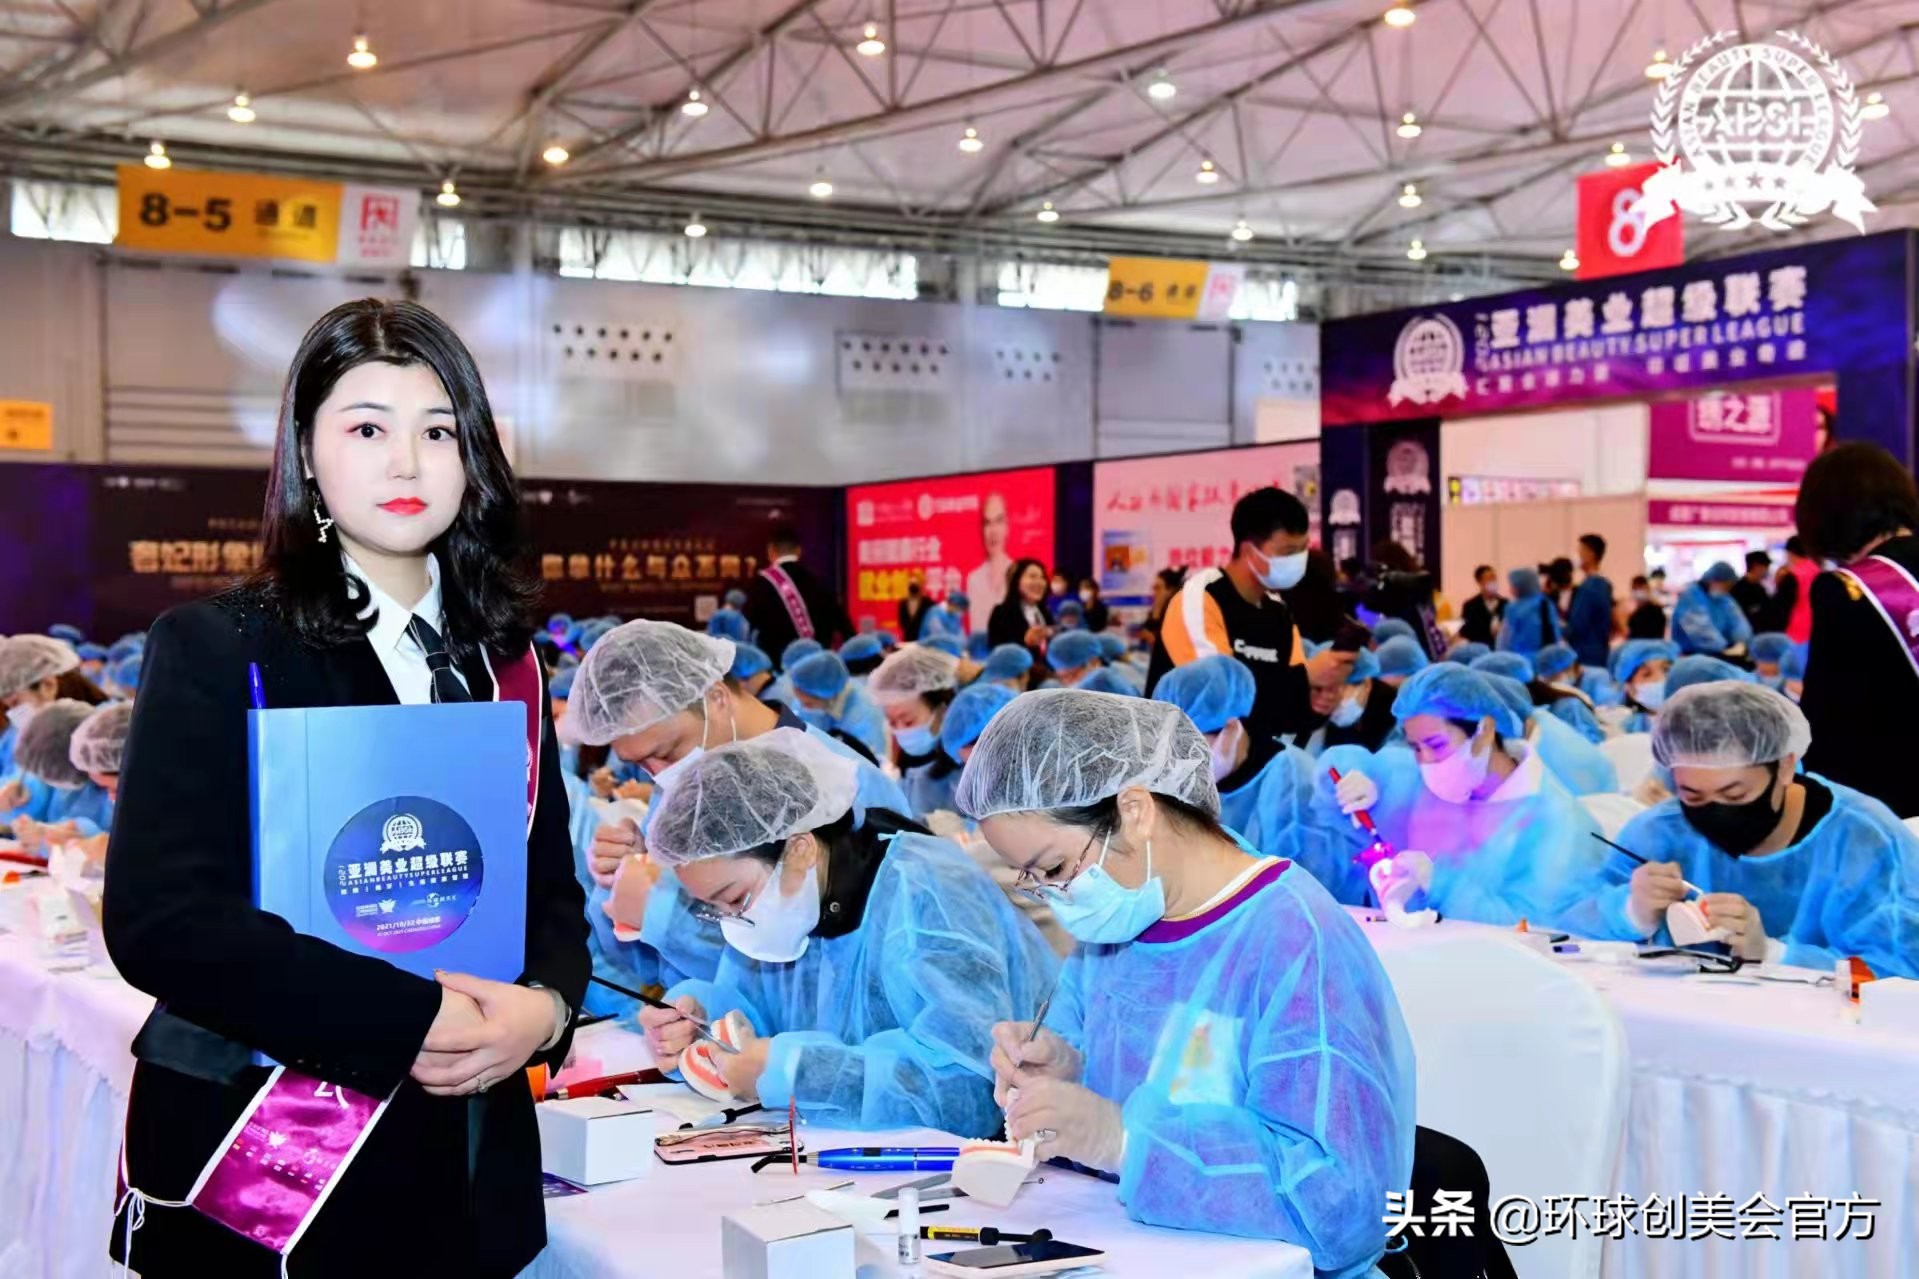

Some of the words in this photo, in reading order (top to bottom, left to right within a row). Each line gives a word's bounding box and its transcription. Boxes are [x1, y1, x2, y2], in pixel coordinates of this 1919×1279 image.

[140, 193, 232, 233] 8-5
[1607, 187, 1649, 258] 8
[1490, 265, 1807, 348] 亚洲美业超级联赛
[1489, 346, 1549, 371] ASIAN
[1551, 335, 1632, 364] BEAUTY
[1634, 325, 1709, 355] SUPER
[1711, 311, 1806, 345] LEAGUE
[347, 850, 469, 879] 亚洲美业超级联赛
